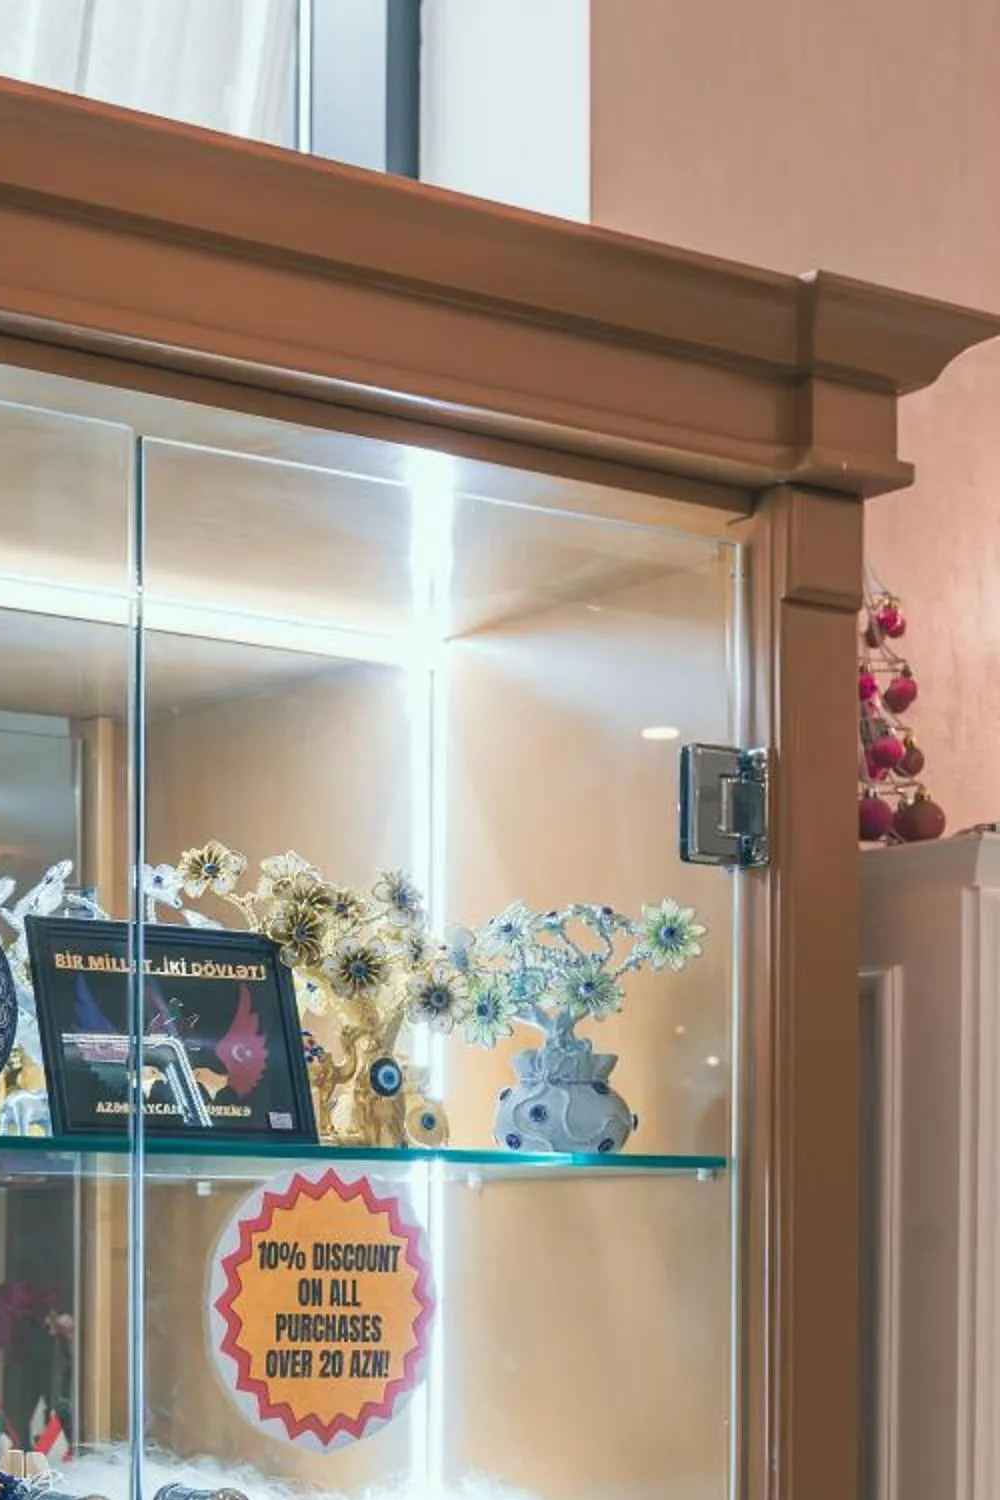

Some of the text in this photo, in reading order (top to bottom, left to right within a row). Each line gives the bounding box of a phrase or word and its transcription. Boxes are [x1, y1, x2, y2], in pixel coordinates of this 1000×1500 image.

[257, 1241, 401, 1272] 10% DISCOUNT
[297, 1277, 361, 1307] ON ALL
[275, 1313, 382, 1343] PURCHASES
[265, 1350, 390, 1379] OVER 20 AZN!
